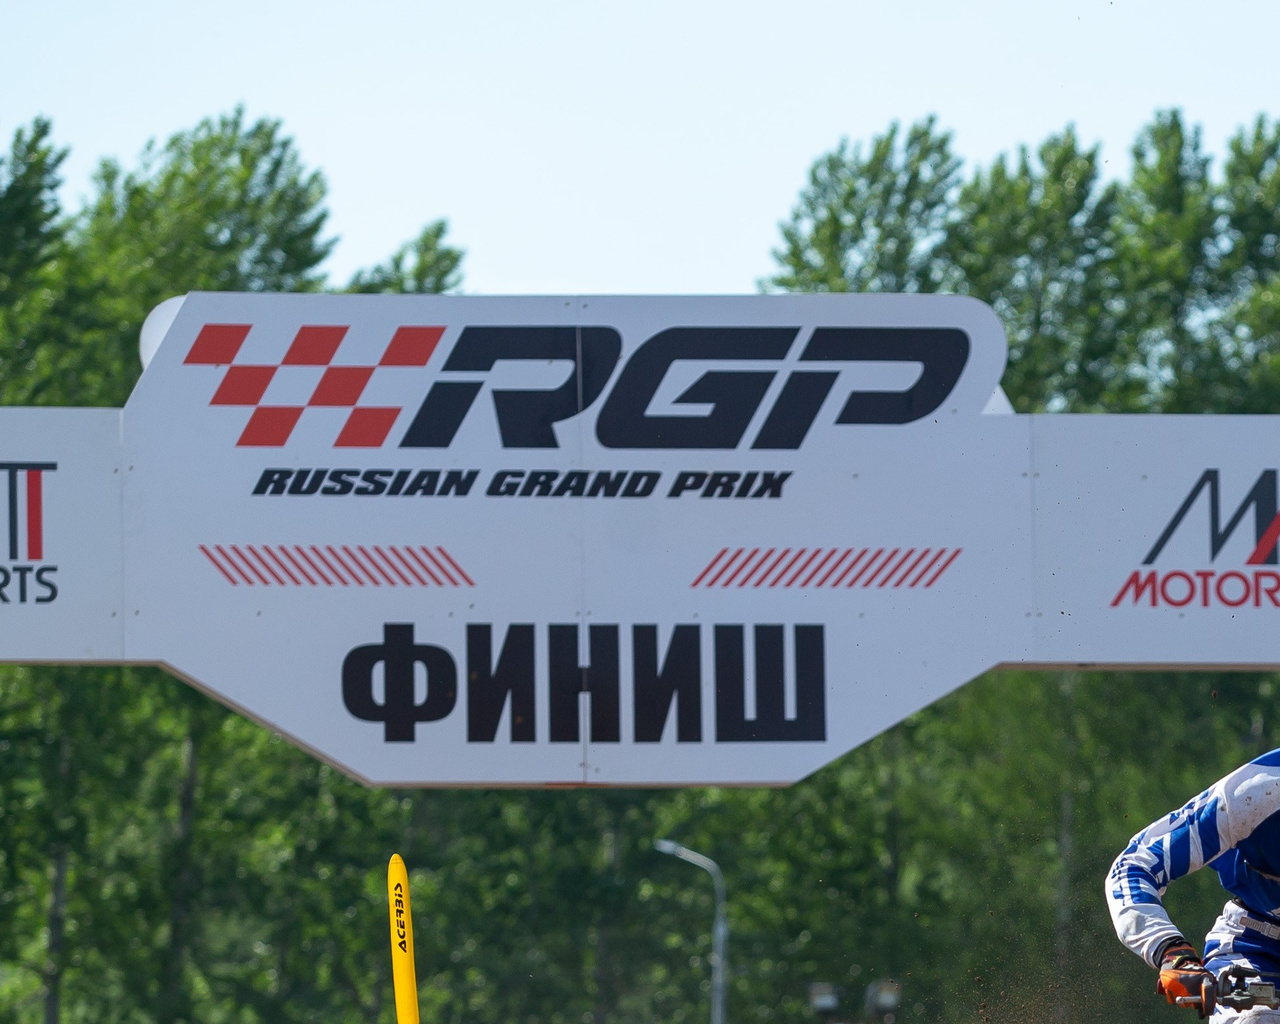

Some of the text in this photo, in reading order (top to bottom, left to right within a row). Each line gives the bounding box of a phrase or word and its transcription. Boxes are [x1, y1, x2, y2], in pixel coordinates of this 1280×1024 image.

[400, 325, 971, 450] RGP
[252, 467, 794, 498] RUSSIAN GRAND PRIX
[341, 623, 828, 744] ФИНИШ
[394, 882, 407, 953] ACERBIS
